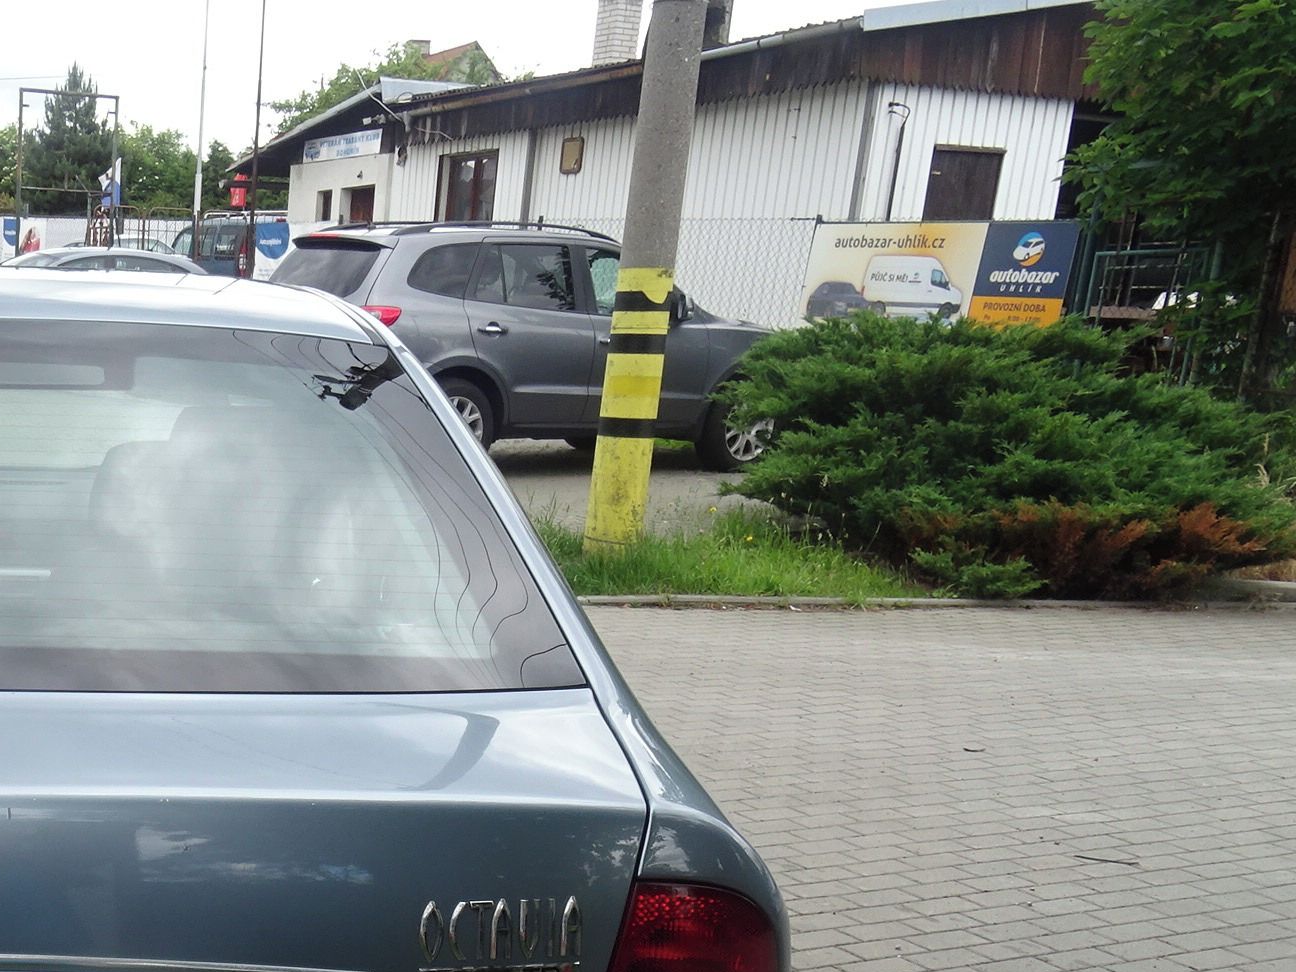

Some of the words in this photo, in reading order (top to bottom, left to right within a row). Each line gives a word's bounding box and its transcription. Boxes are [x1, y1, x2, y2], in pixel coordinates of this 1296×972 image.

[834, 234, 946, 249] autobazar-uhlik.cz
[989, 269, 1060, 284] autobazar
[1000, 284, 1043, 293] UHLÍK
[983, 302, 1022, 312] PROVOZNÍ
[1023, 304, 1046, 313] DOBA
[419, 895, 583, 963] OCTAVIA
